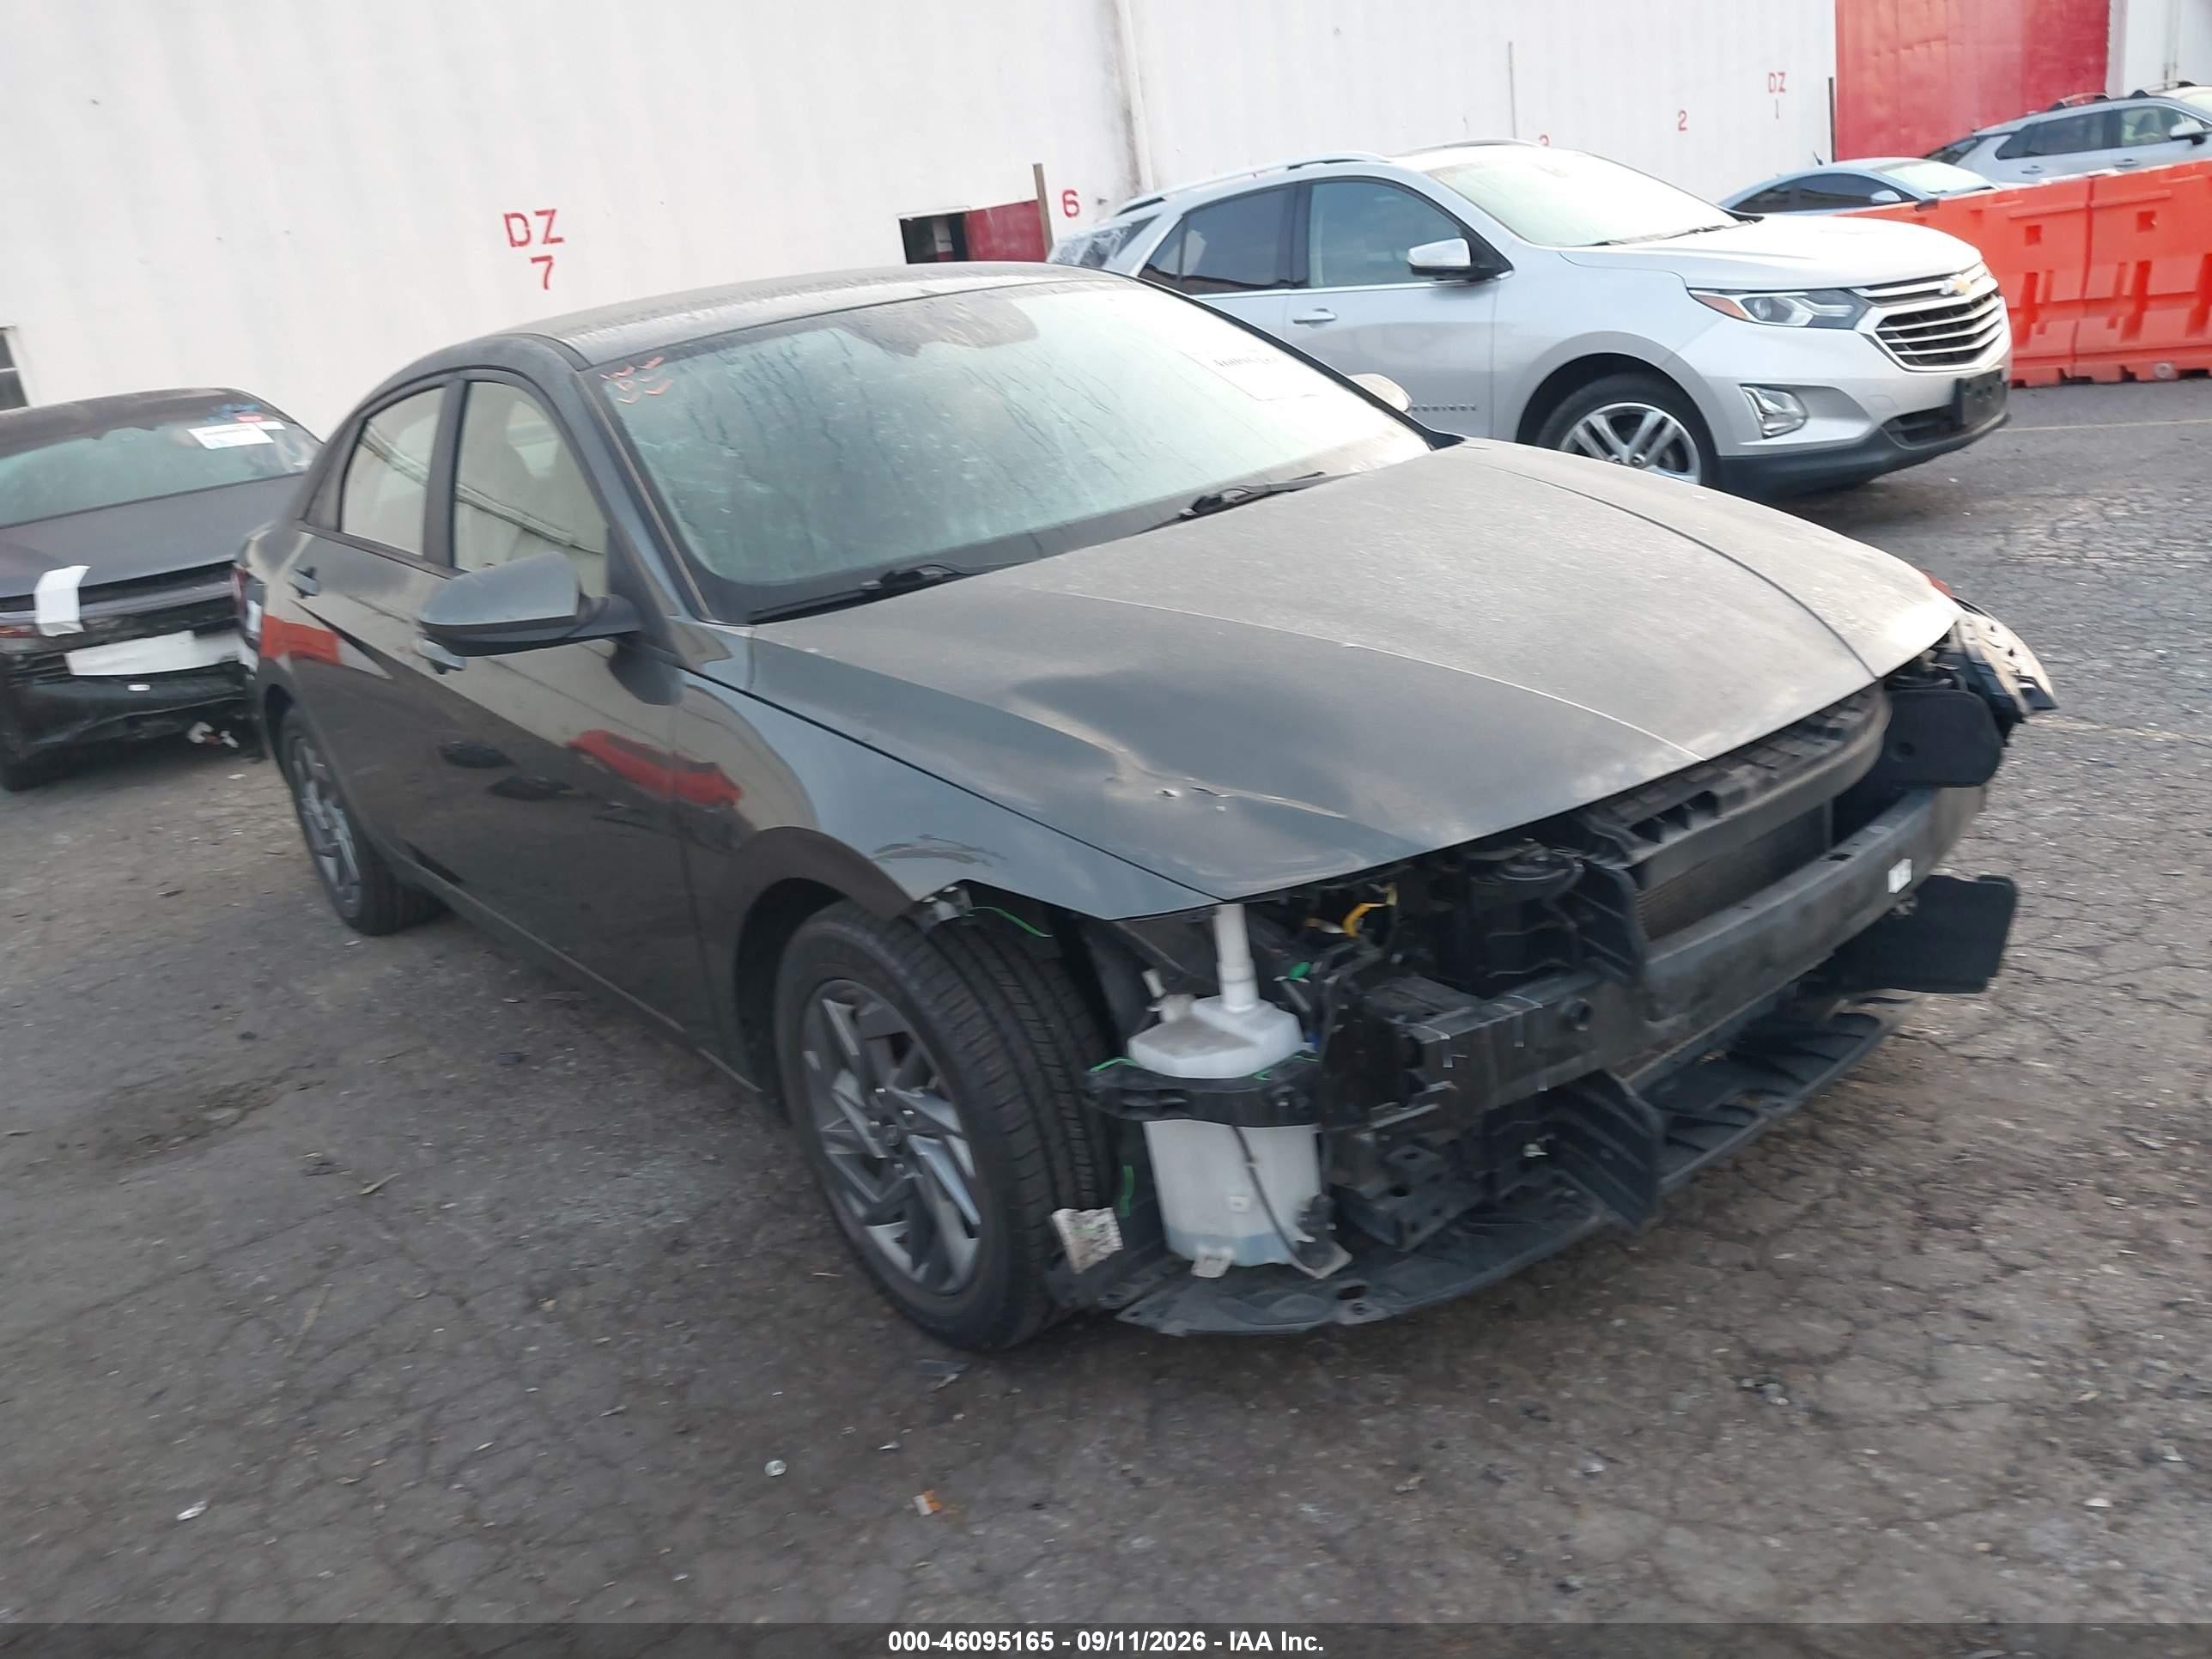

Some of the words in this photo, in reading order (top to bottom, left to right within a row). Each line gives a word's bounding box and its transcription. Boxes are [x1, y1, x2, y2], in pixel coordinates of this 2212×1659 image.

[1768, 72, 1786, 94] DZ
[1678, 110, 1687, 131] 2
[1062, 189, 1079, 218] 6
[504, 209, 564, 247] DZ
[530, 255, 553, 289] 7
